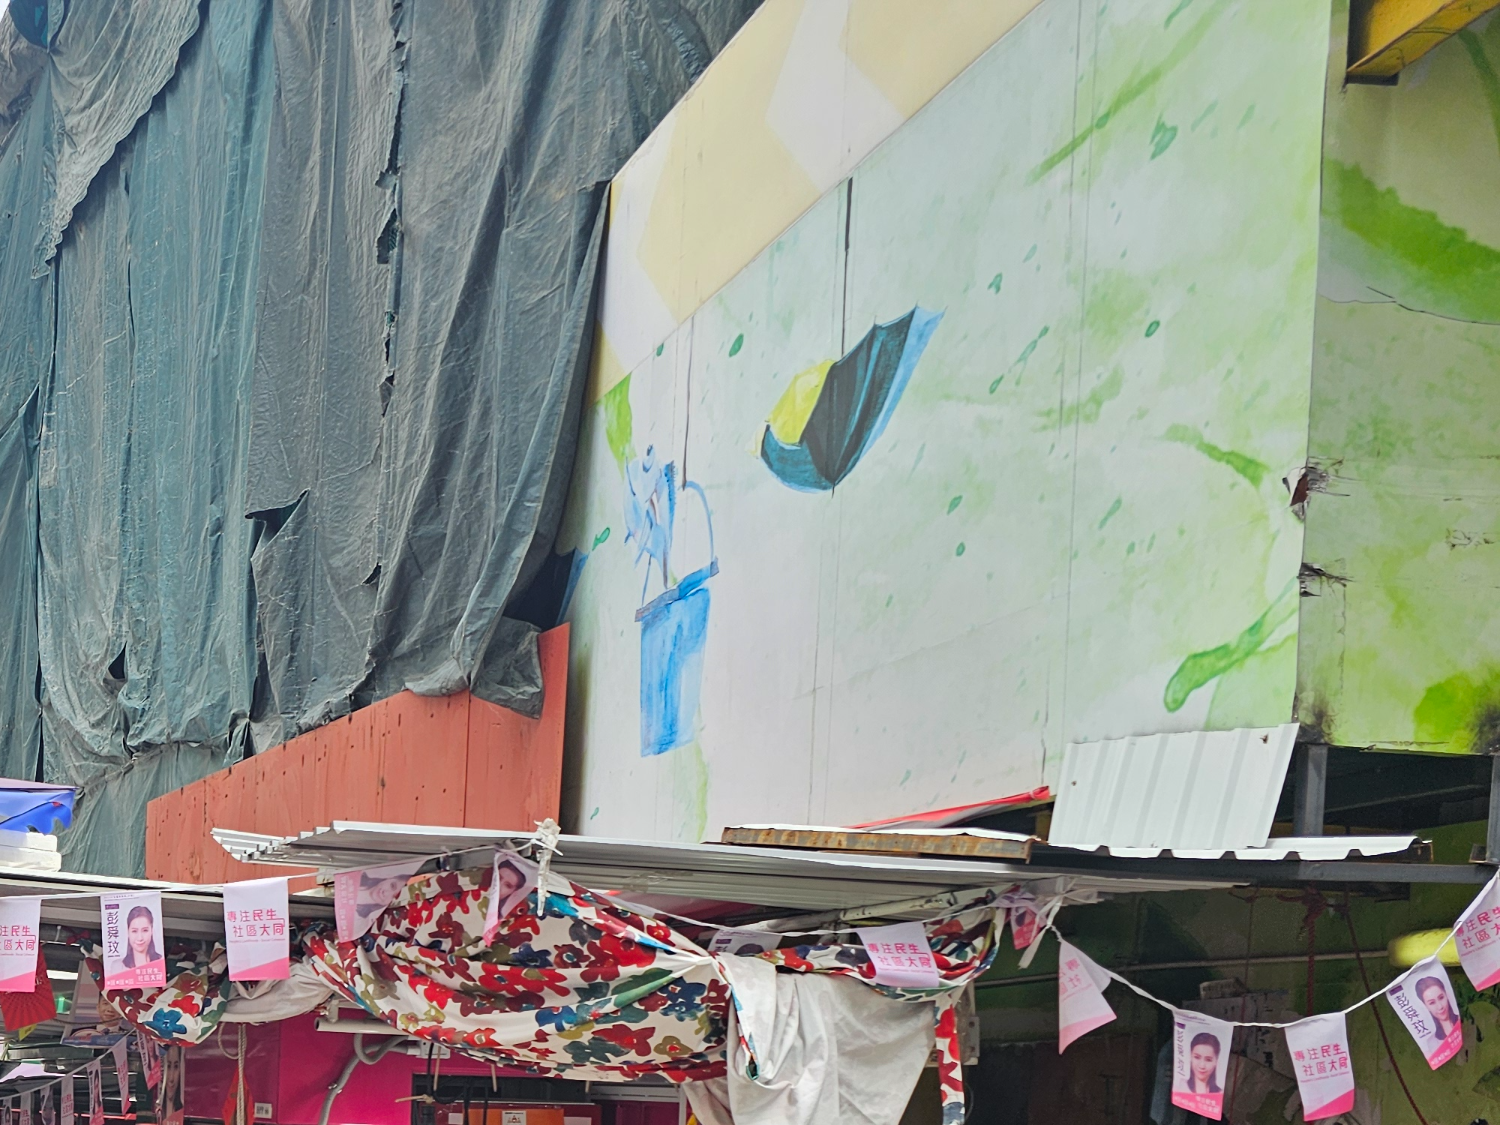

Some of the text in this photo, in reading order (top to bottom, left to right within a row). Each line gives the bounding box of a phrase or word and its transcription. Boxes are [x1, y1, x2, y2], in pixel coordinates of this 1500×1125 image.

[226, 908, 277, 922] 專注民生
[106, 910, 120, 955] 彭舜玟
[232, 922, 285, 938] 社區大同
[867, 942, 919, 954] 專注民生
[877, 955, 932, 969] 社區大同
[1293, 1042, 1343, 1063] 專注民生
[1302, 1056, 1349, 1077] 社區大同
